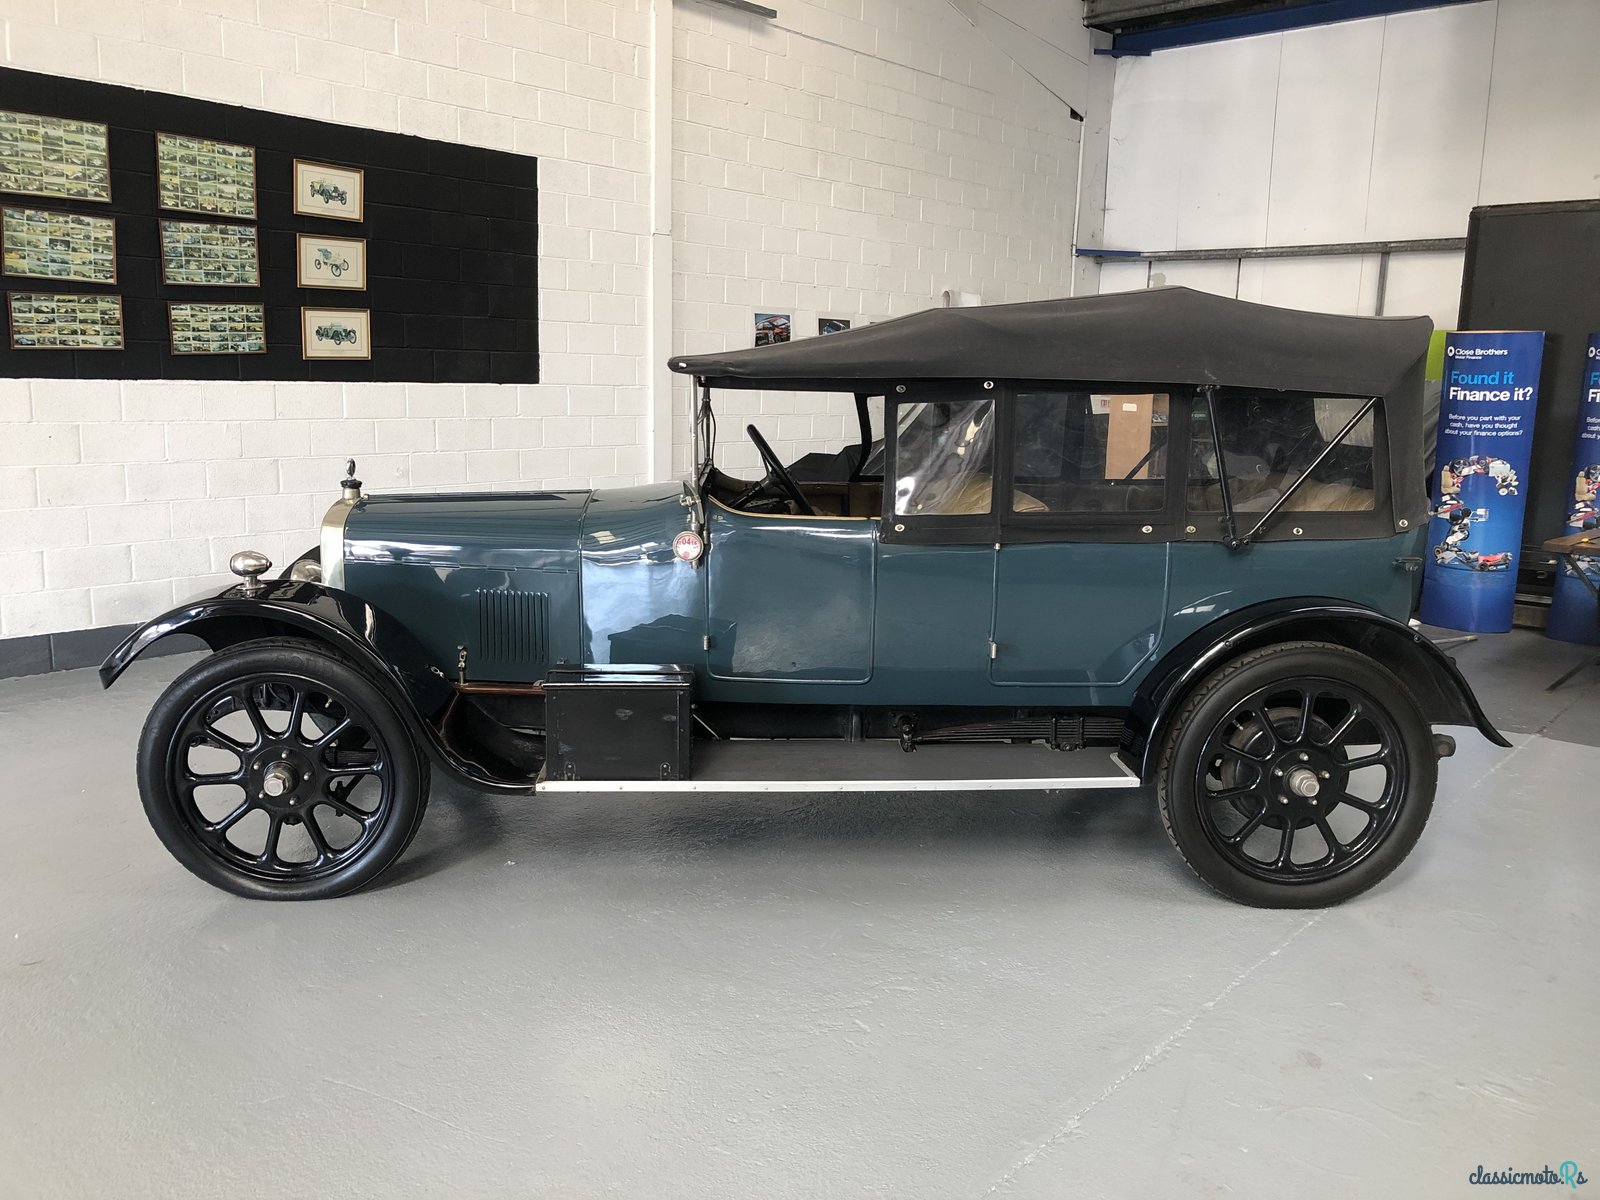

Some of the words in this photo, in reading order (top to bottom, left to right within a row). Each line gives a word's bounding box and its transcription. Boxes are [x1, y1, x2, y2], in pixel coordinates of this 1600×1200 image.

[1450, 370, 1499, 384] Found
[1503, 371, 1514, 384] it
[1449, 387, 1510, 401] Finance
[1514, 387, 1533, 401] it?
